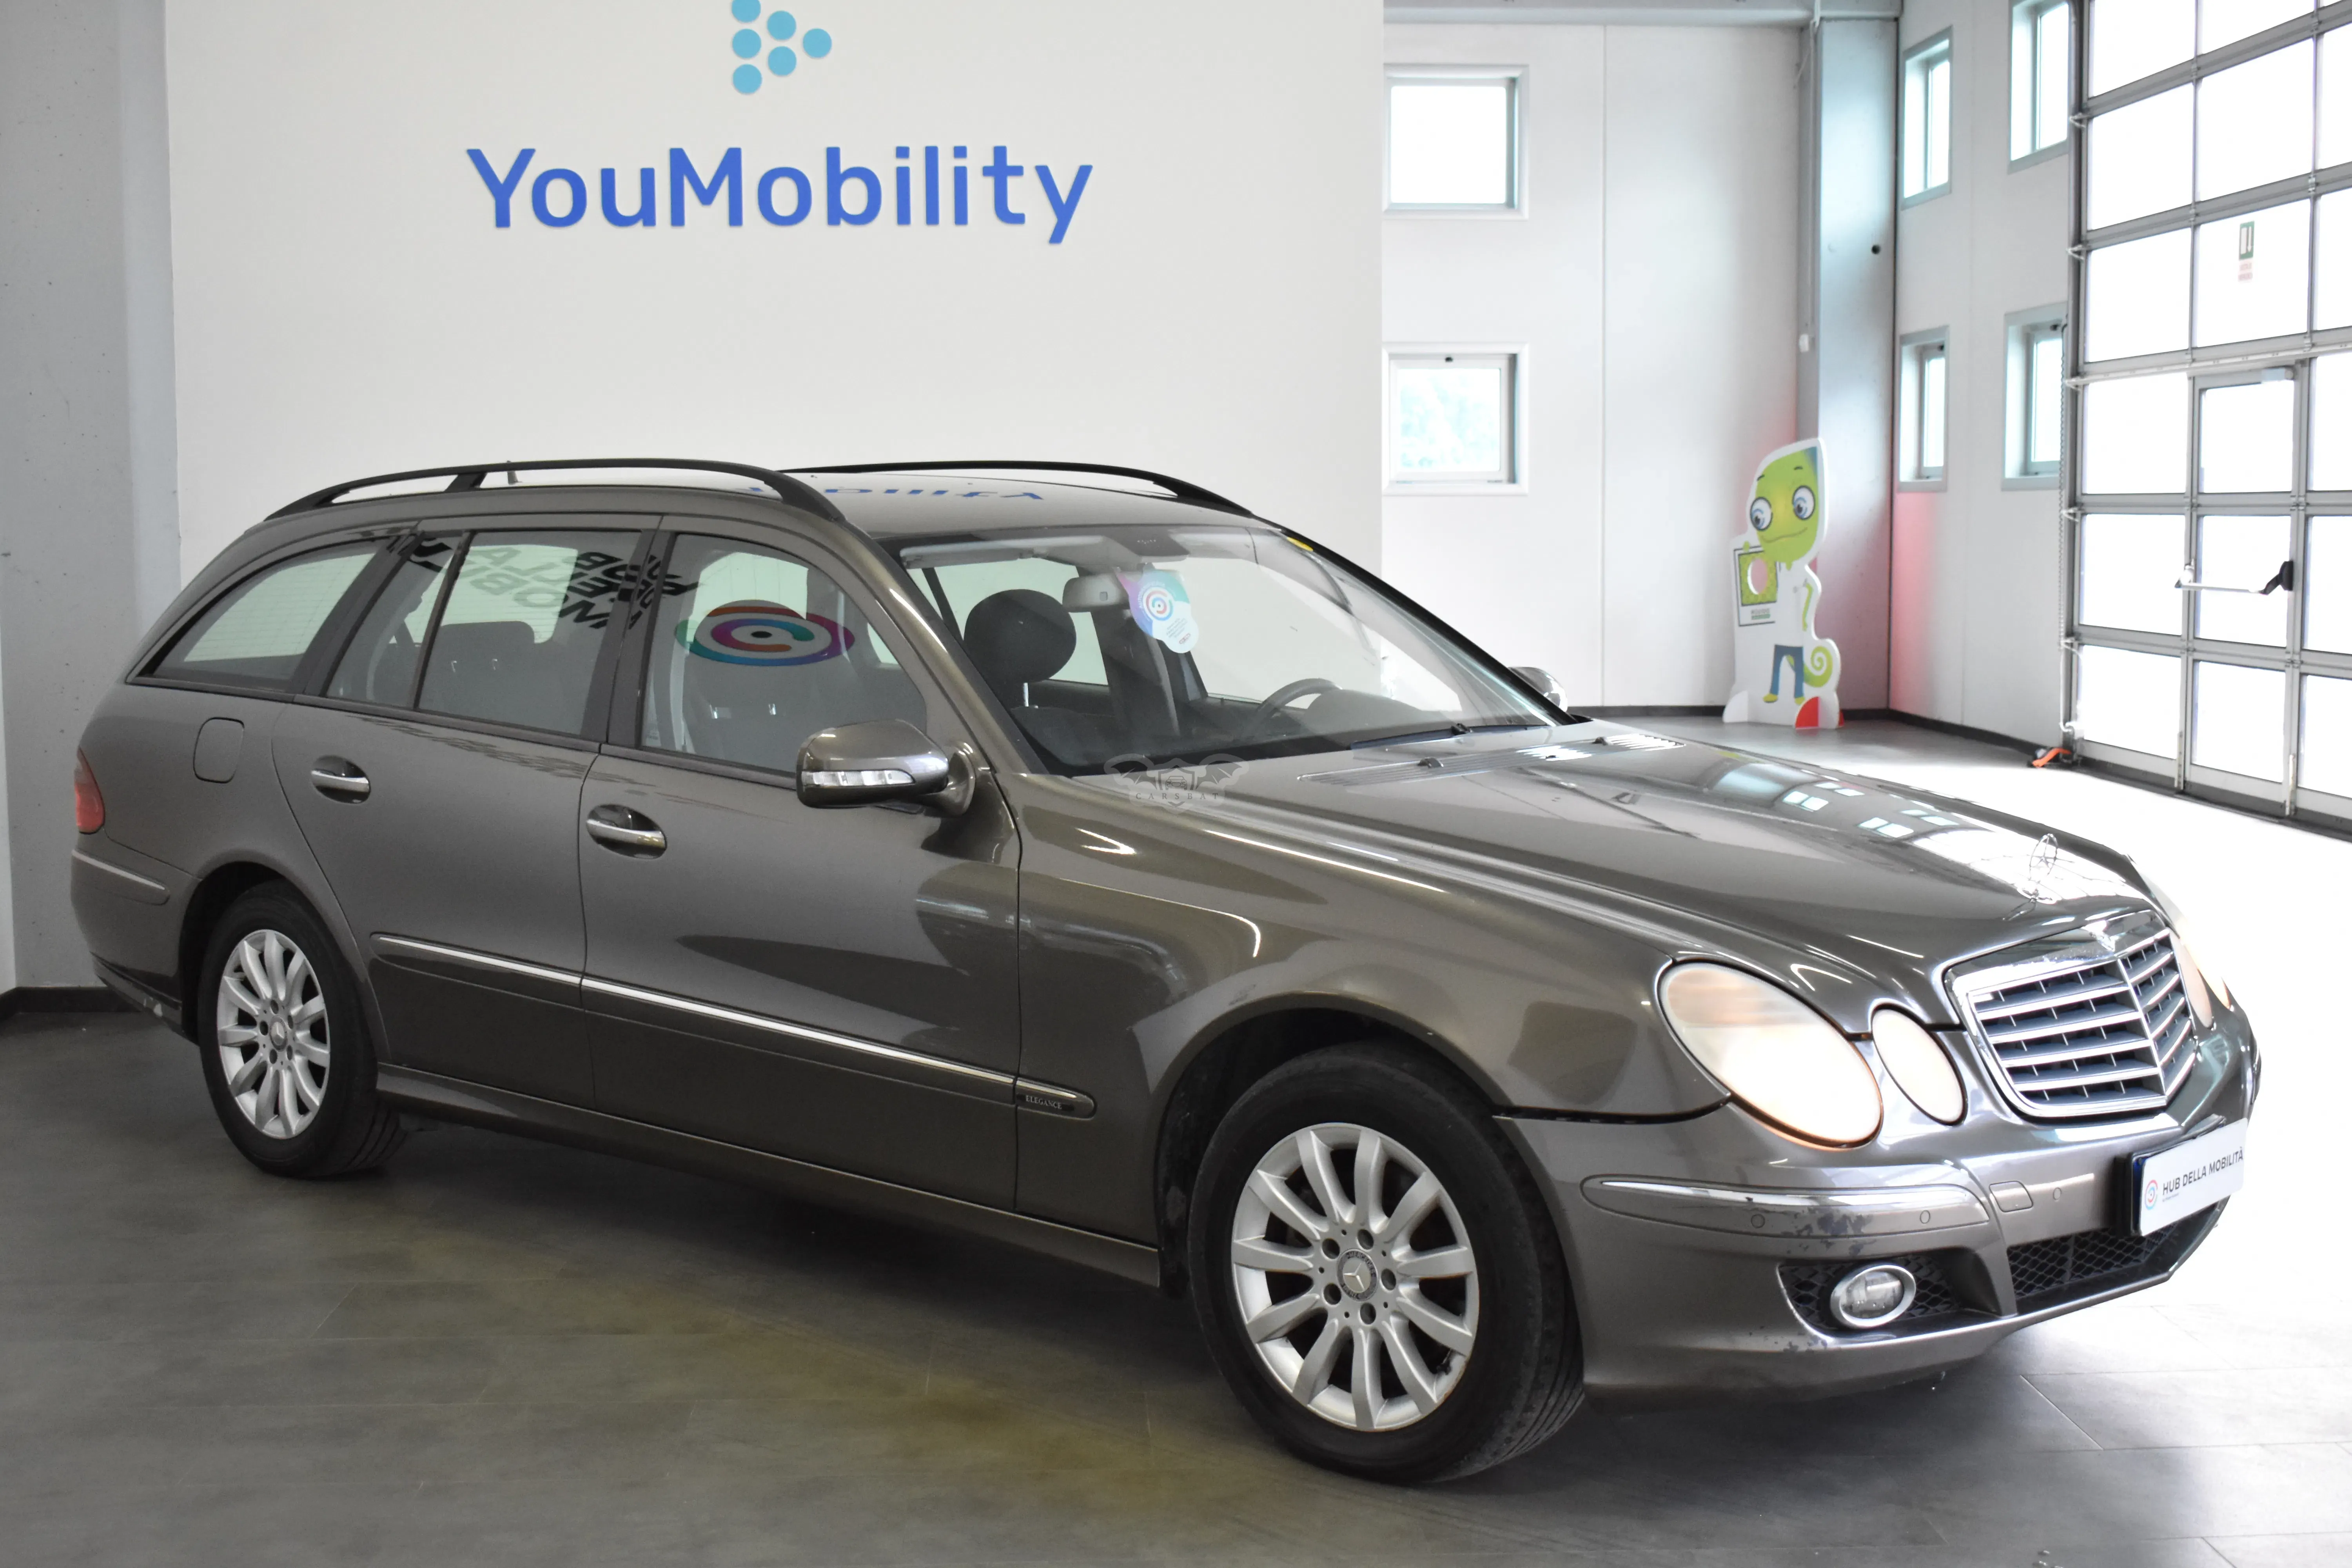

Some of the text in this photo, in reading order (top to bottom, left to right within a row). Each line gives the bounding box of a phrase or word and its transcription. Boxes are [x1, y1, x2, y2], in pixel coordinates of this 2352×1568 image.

[466, 145, 1093, 244] YouMobility
[1026, 1095, 1062, 1109] ELEGANCE
[2163, 1146, 2243, 1195] HUB DELLA MOBILITÀ
